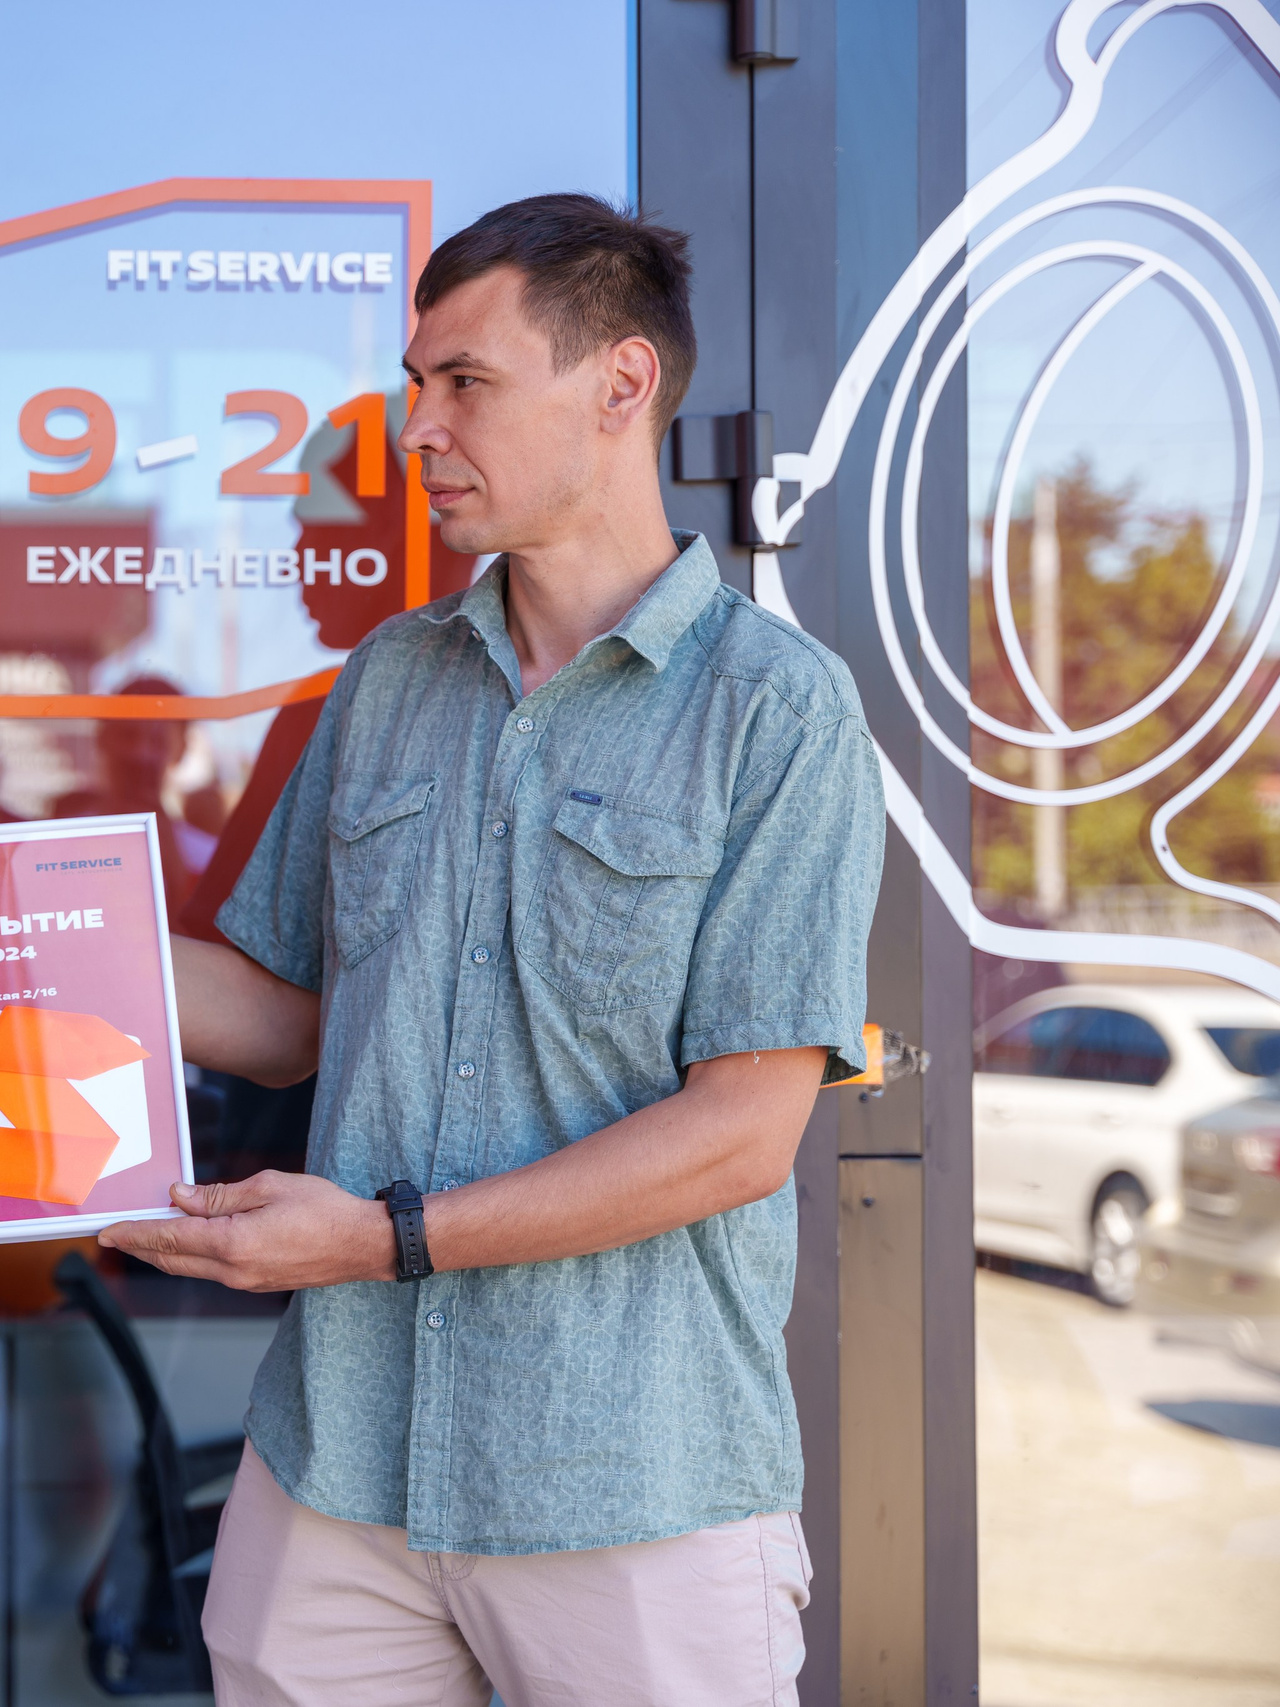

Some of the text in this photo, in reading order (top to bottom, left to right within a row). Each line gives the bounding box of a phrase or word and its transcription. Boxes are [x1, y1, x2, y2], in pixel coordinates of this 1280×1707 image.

[107, 249, 393, 284] FIT SERVICE
[26, 545, 389, 591] ЕЖЕДНЕВНО
[35, 862, 58, 872] FIT
[60, 857, 122, 871] SERVICE
[23, 987, 58, 1000] 2/16
